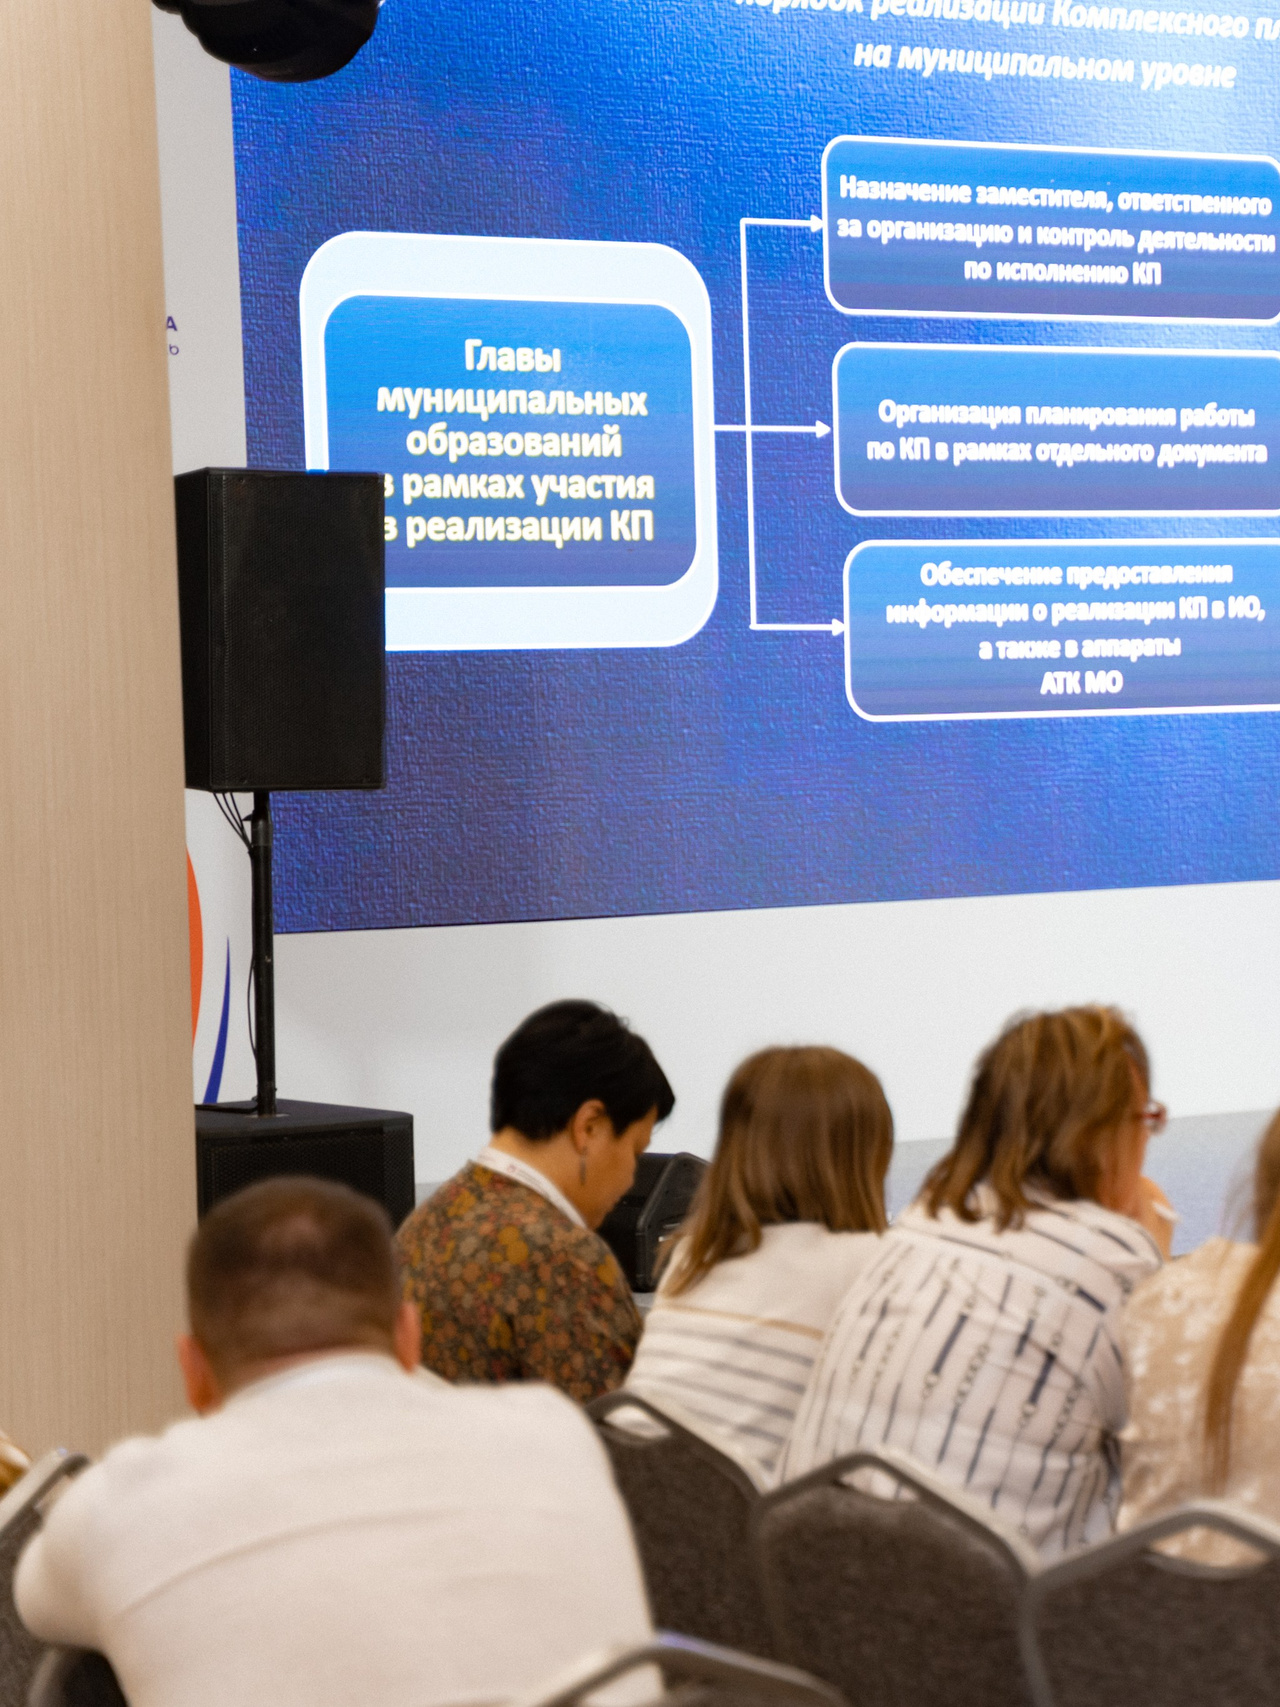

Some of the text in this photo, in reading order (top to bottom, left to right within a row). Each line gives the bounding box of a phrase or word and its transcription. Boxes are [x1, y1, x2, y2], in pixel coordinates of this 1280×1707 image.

[870, 0, 1046, 29] реализации
[1052, 1, 1250, 38] Комплексного
[853, 43, 1237, 91] на муниципальном уровне
[840, 174, 972, 203] Назначение
[1117, 192, 1273, 216] ответственного
[837, 218, 1276, 254] за организацию и контроль деятельности
[964, 260, 1162, 285] по исполнению КП
[465, 339, 561, 372] Главы
[377, 387, 648, 422] муниципальных
[878, 399, 1256, 432] Организация планирования работы
[406, 420, 622, 463] образований
[866, 436, 1268, 468] по КП в рамках отдельного документа
[403, 473, 525, 505] рамках
[530, 474, 655, 506] участия
[406, 516, 602, 549] реализации
[610, 509, 654, 541] КП
[920, 560, 1233, 590] Обеспечение предоставления
[886, 597, 1029, 629] информации
[1032, 603, 1048, 622] о
[1051, 601, 1176, 627] реализации
[1179, 595, 1208, 619] КП
[1211, 600, 1226, 619] в
[978, 637, 1182, 663] а также в аппараты
[1040, 669, 1124, 695] АТК МО
